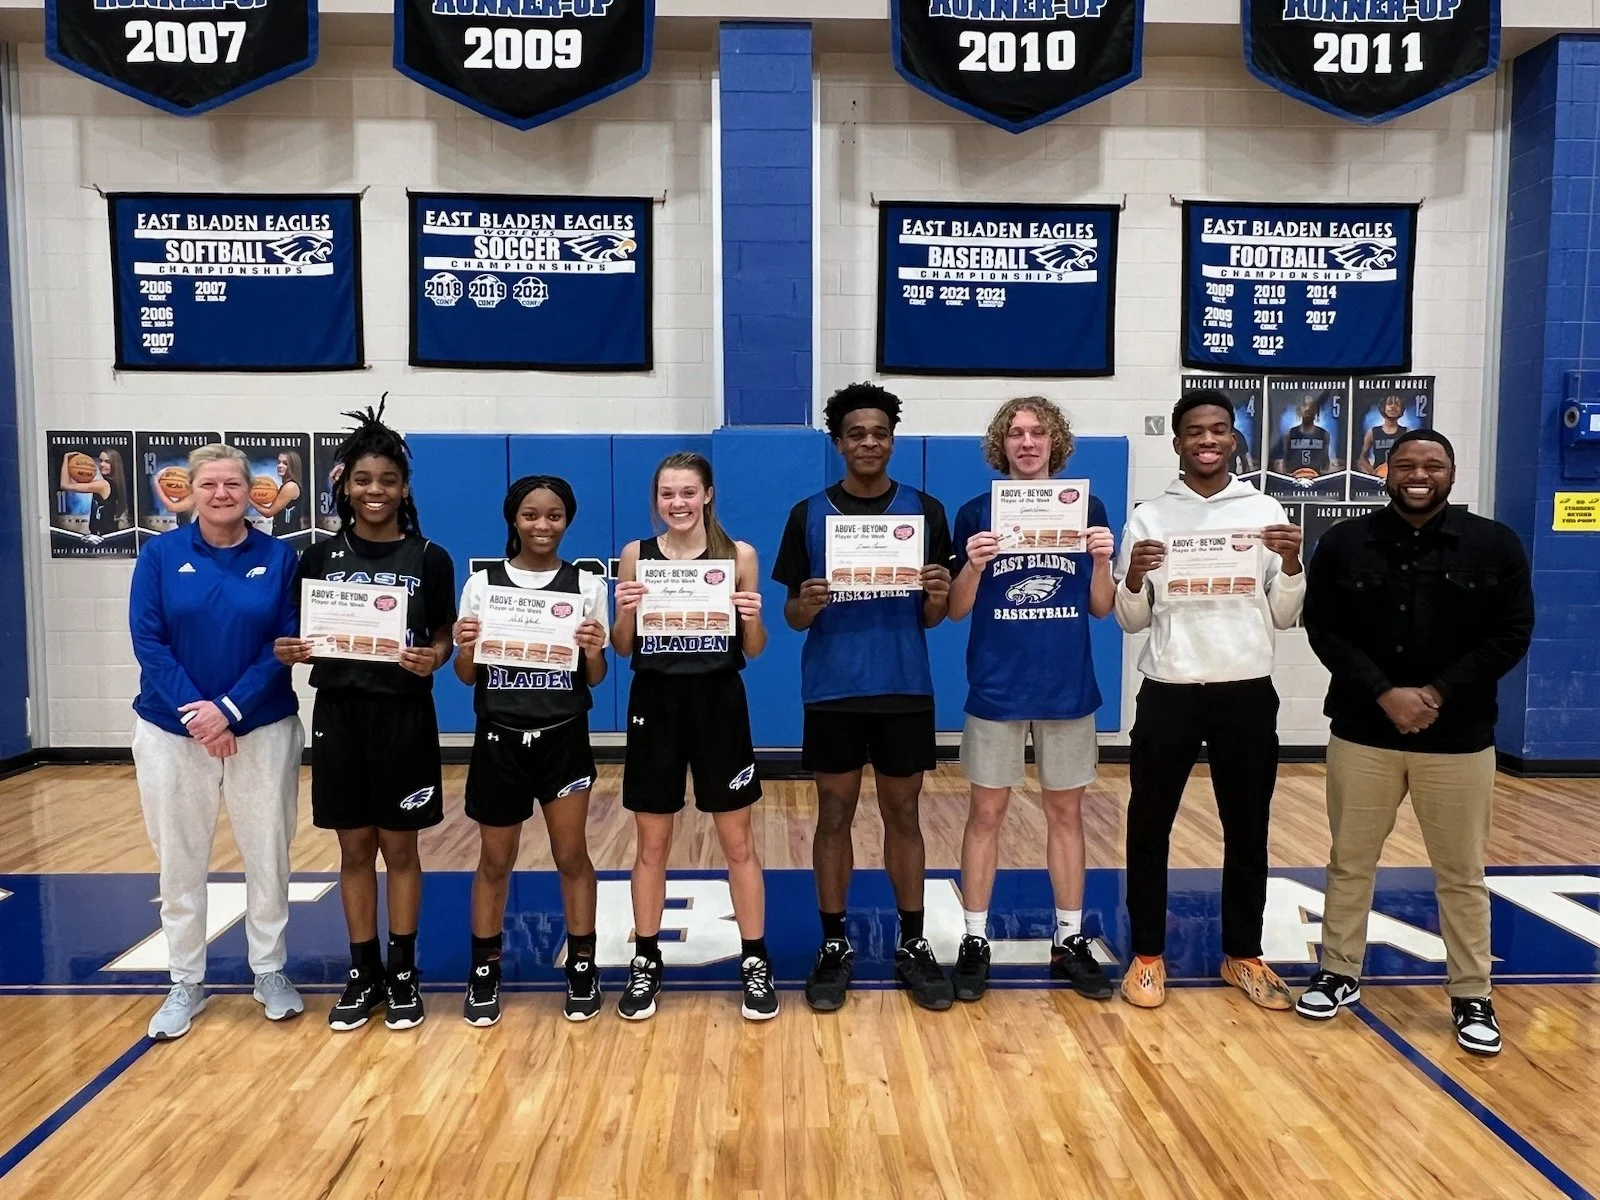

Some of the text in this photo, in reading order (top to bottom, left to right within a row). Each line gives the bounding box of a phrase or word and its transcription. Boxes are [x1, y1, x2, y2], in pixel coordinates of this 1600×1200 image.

[929, 0, 1107, 21] RUNNER-UP
[1283, 0, 1461, 23] RUNNER-UP
[124, 20, 247, 64] 2007
[463, 27, 582, 70] 2009
[958, 30, 1076, 72] 2010
[1313, 32, 1424, 74] 2011
[137, 213, 330, 231] EAST BLADEN EAGLES
[425, 210, 634, 230] EAST BLADEN EAGLES
[902, 219, 1094, 239] EAST BLADEN EAGLES
[1203, 218, 1393, 238] EAST BLADEN EAGLES
[165, 240, 266, 263] SOFTBALL
[474, 235, 561, 261] SOCCER
[928, 246, 1028, 269] BASEBALL
[1229, 245, 1328, 268] FOOTBALL
[159, 265, 303, 275] CHAMPIONSHIPS
[450, 260, 606, 271] CHAMPIONSHIPS
[920, 270, 1063, 281] CHAMPIONSHIPS
[1220, 269, 1363, 280] CHAMPIONSHIPS
[140, 280, 172, 294] 2006
[195, 281, 227, 295] 2007
[426, 281, 462, 297] 2018
[469, 282, 506, 298] 2019
[513, 285, 548, 299] 2021
[902, 285, 934, 298] 2016
[939, 286, 970, 300] 2021
[976, 287, 1006, 301] 2021
[1206, 282, 1235, 297] 2009
[1254, 285, 1286, 298] 2010
[1306, 285, 1337, 298] 2014
[141, 307, 173, 320] 2006
[1204, 307, 1233, 321] 2009
[1253, 310, 1283, 323] 2011
[1305, 311, 1336, 324] 2017
[142, 333, 174, 346] 2007
[1203, 333, 1234, 347] 2010
[1252, 335, 1284, 349] 2012
[1185, 379, 1224, 389] MALCOLM
[1359, 380, 1428, 389] MALAKI MONROE
[1246, 395, 1256, 417] 4
[1333, 396, 1340, 418] 5
[1415, 395, 1427, 417] 12
[149, 436, 208, 446] KARLI PRIEST
[144, 453, 156, 475] 13
[1000, 489, 1021, 497] ABOVE
[1027, 488, 1053, 497] BEYOND
[57, 491, 66, 513] 11
[1317, 508, 1342, 517] JACOB
[835, 524, 856, 533] ABOVE
[862, 524, 888, 532] BEYOND
[1172, 537, 1226, 547] ABOVE BEYOND
[645, 569, 666, 577] ABOVE
[672, 568, 698, 577] BEYOND
[992, 554, 1076, 577] EAST BLADEN
[311, 589, 368, 602] ABOVE BEYOND
[489, 595, 546, 608] ABOVE BEYOND
[993, 606, 1079, 620] BASKETBALL
[640, 635, 729, 654] BLADEN
[487, 664, 573, 690] BLADEN
